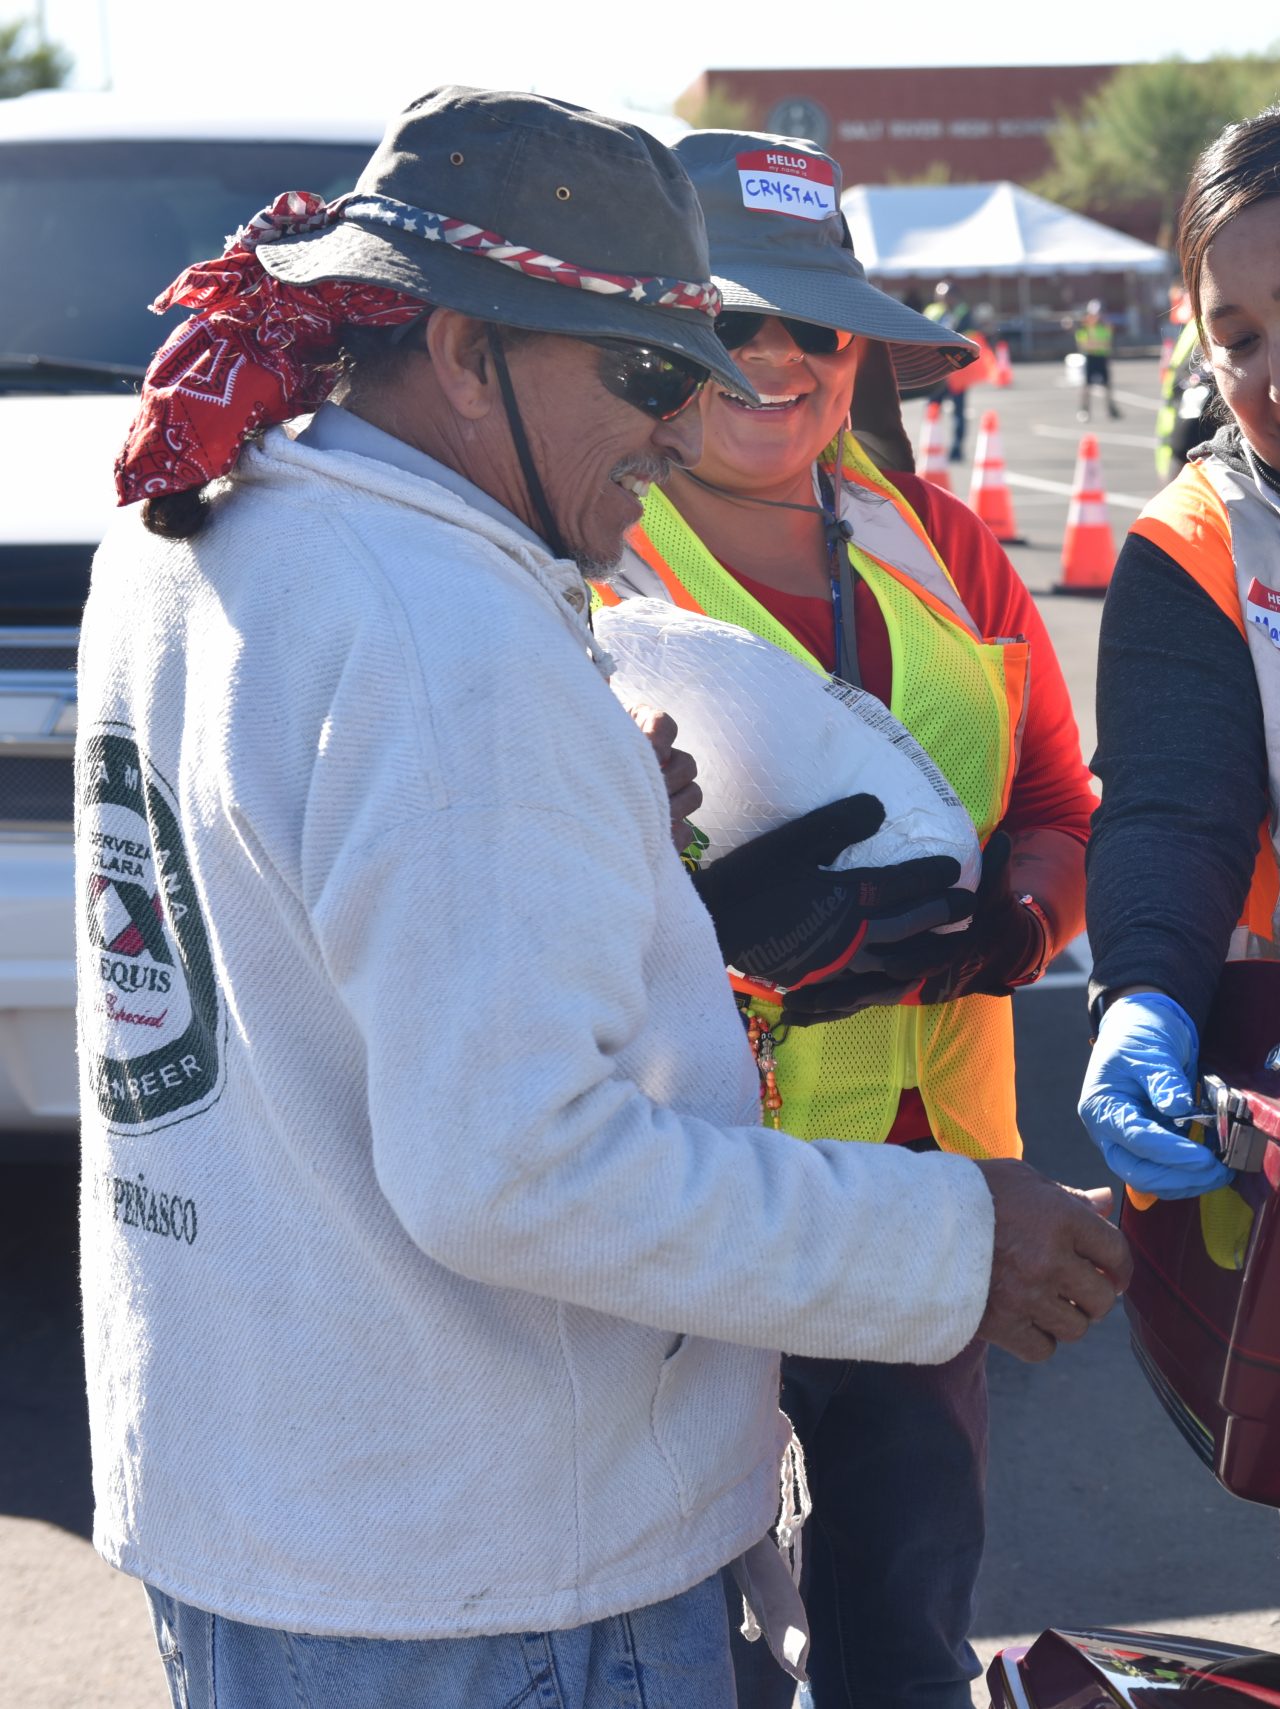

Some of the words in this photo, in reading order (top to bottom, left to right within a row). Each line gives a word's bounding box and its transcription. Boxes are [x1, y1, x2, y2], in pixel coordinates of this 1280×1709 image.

[766, 154, 807, 169] HELLO
[745, 179, 828, 208] CRYSTAL
[127, 1054, 202, 1100] BEER
